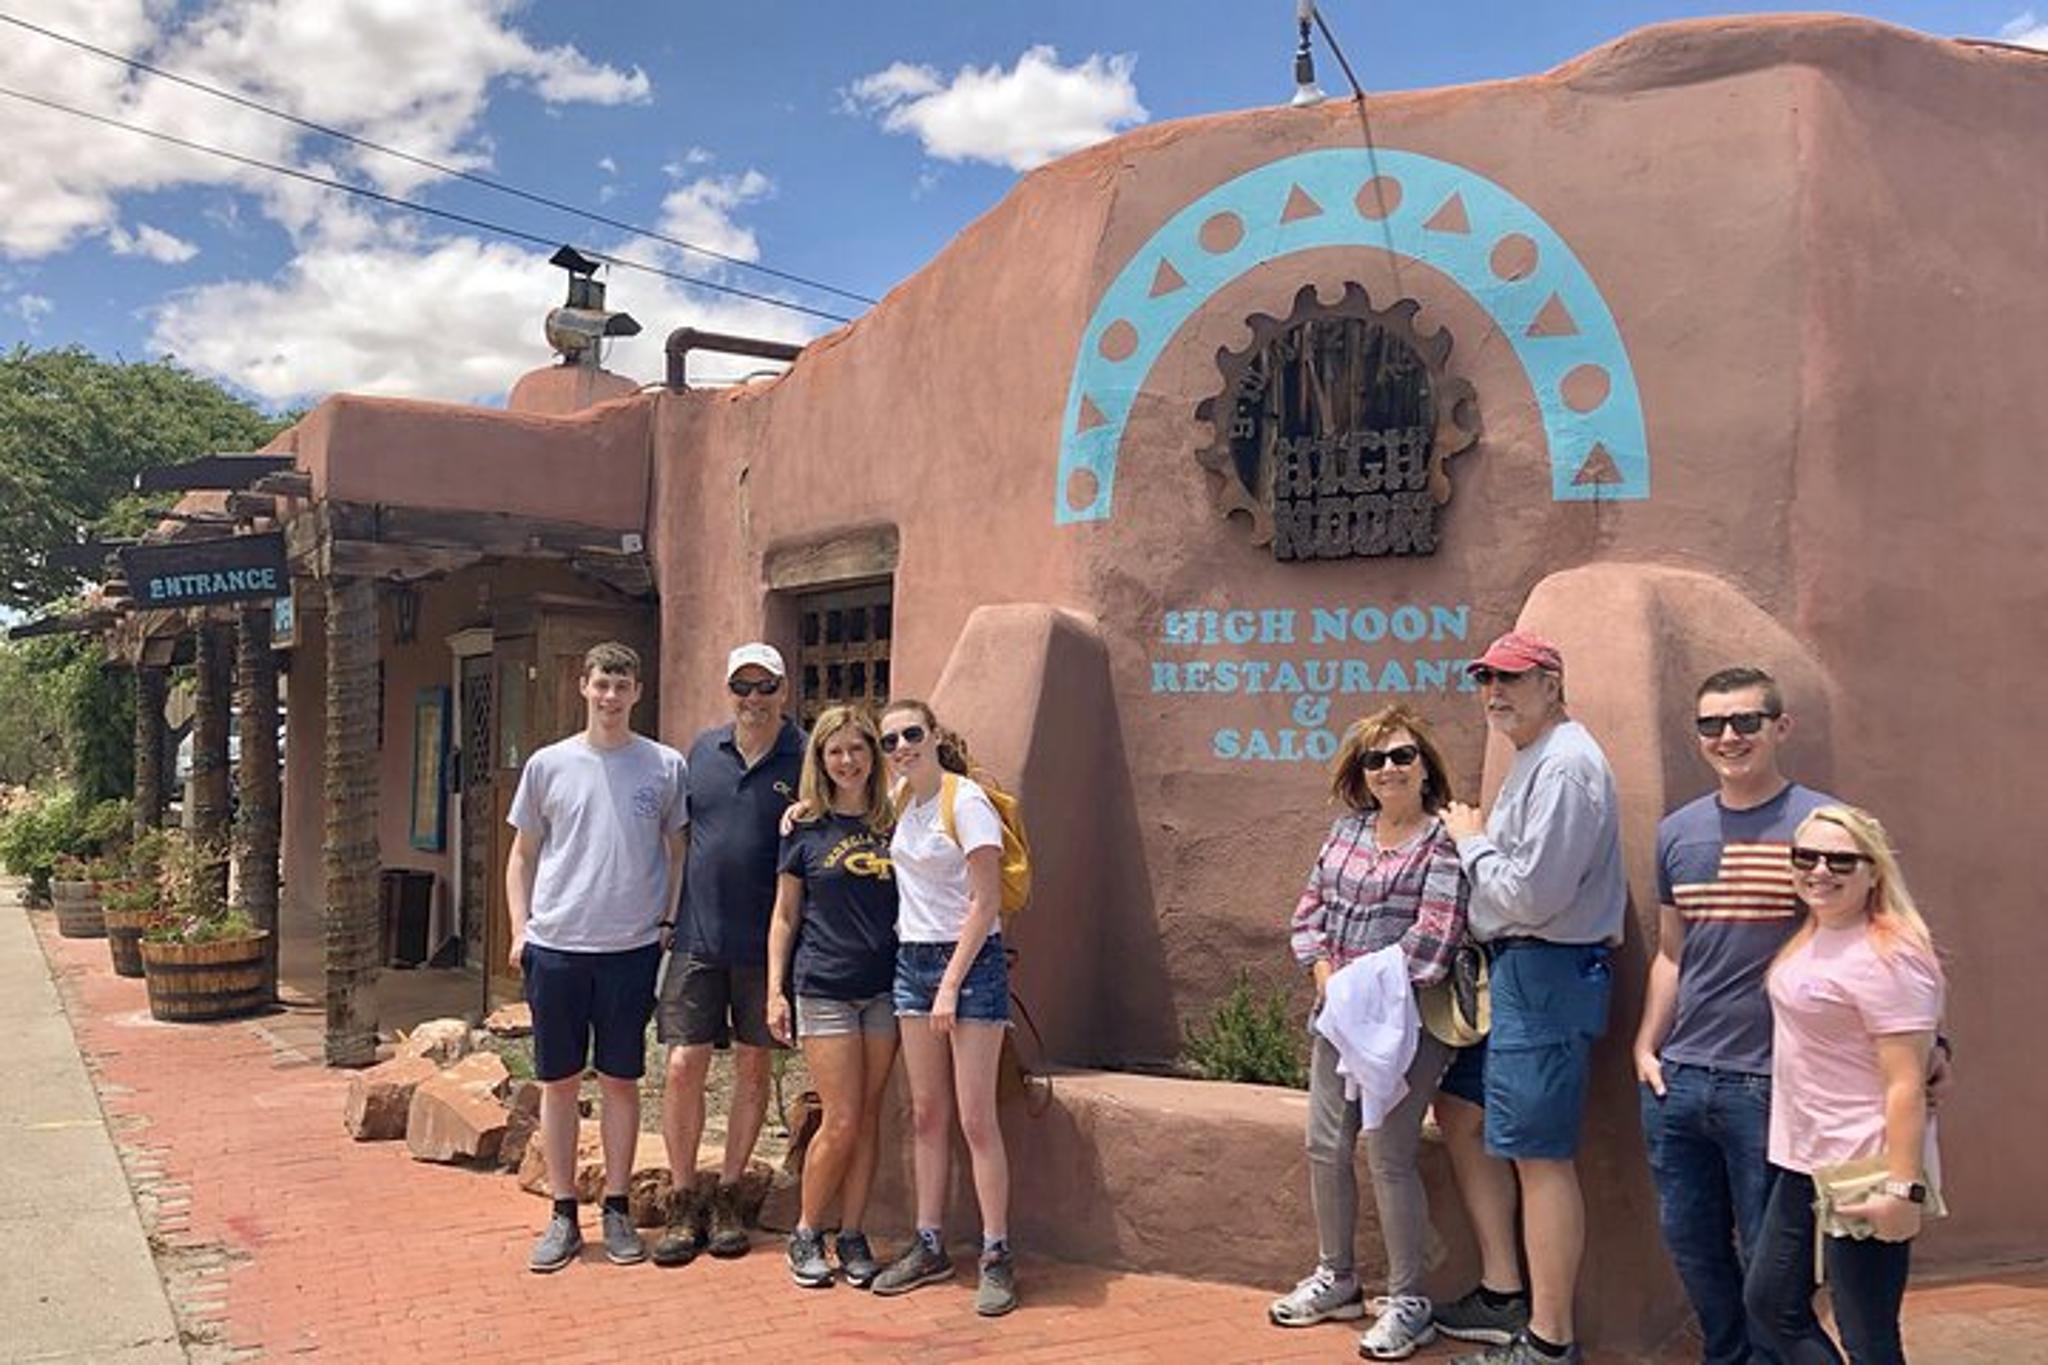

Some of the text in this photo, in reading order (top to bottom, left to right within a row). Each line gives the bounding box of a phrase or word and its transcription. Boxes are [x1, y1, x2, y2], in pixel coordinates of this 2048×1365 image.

[150, 568, 277, 598] ENTRANCE
[1162, 604, 1471, 644] HIGH NOON
[1150, 659, 1478, 693] RESTAURANT
[1292, 694, 1332, 727] &
[1212, 728, 1341, 762] SALO
